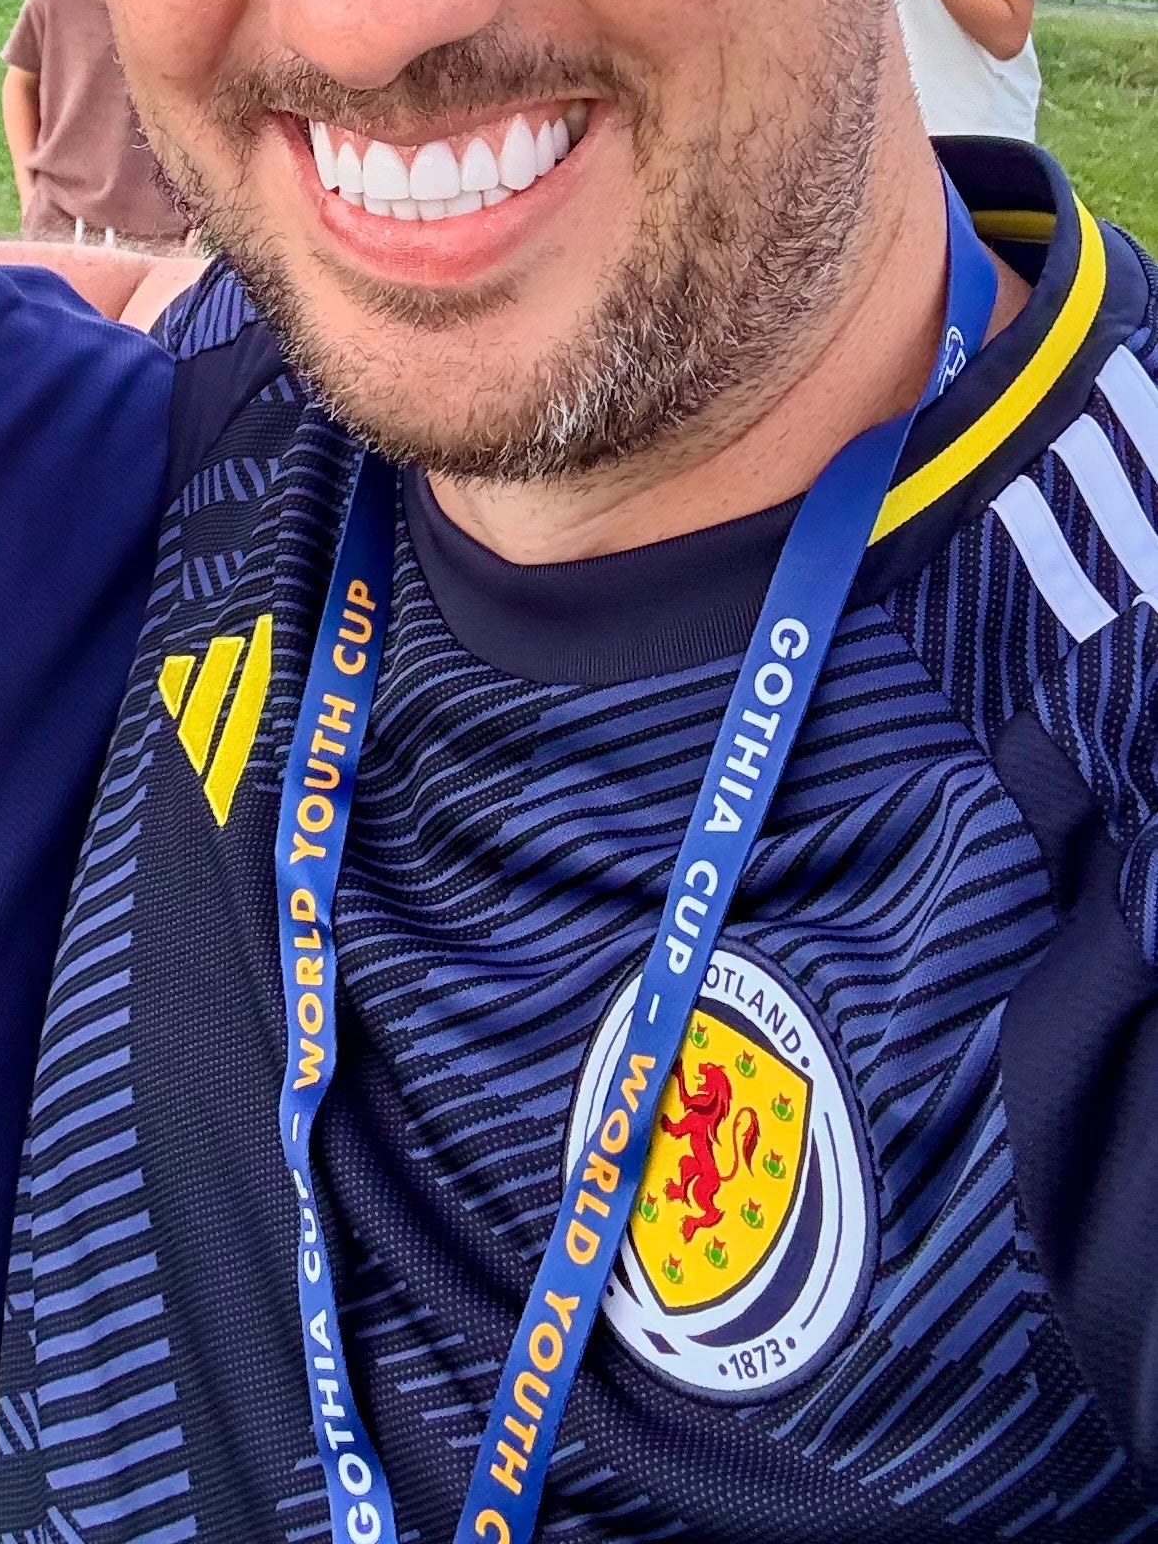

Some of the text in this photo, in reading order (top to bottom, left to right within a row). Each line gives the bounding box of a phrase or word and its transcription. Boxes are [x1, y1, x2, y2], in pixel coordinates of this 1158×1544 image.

[332, 578, 376, 676] CUP
[291, 694, 355, 861] YOUTH
[703, 616, 810, 833] GOTHIA
[291, 888, 325, 1090] WORLD
[664, 859, 718, 975] CUP
[704, 964, 801, 1054] OTLAND
[567, 1053, 658, 1264] WORLD
[309, 1308, 382, 1544] GOTHIA
[491, 1291, 580, 1495] YOUTH
[728, 1338, 787, 1380] 1873
